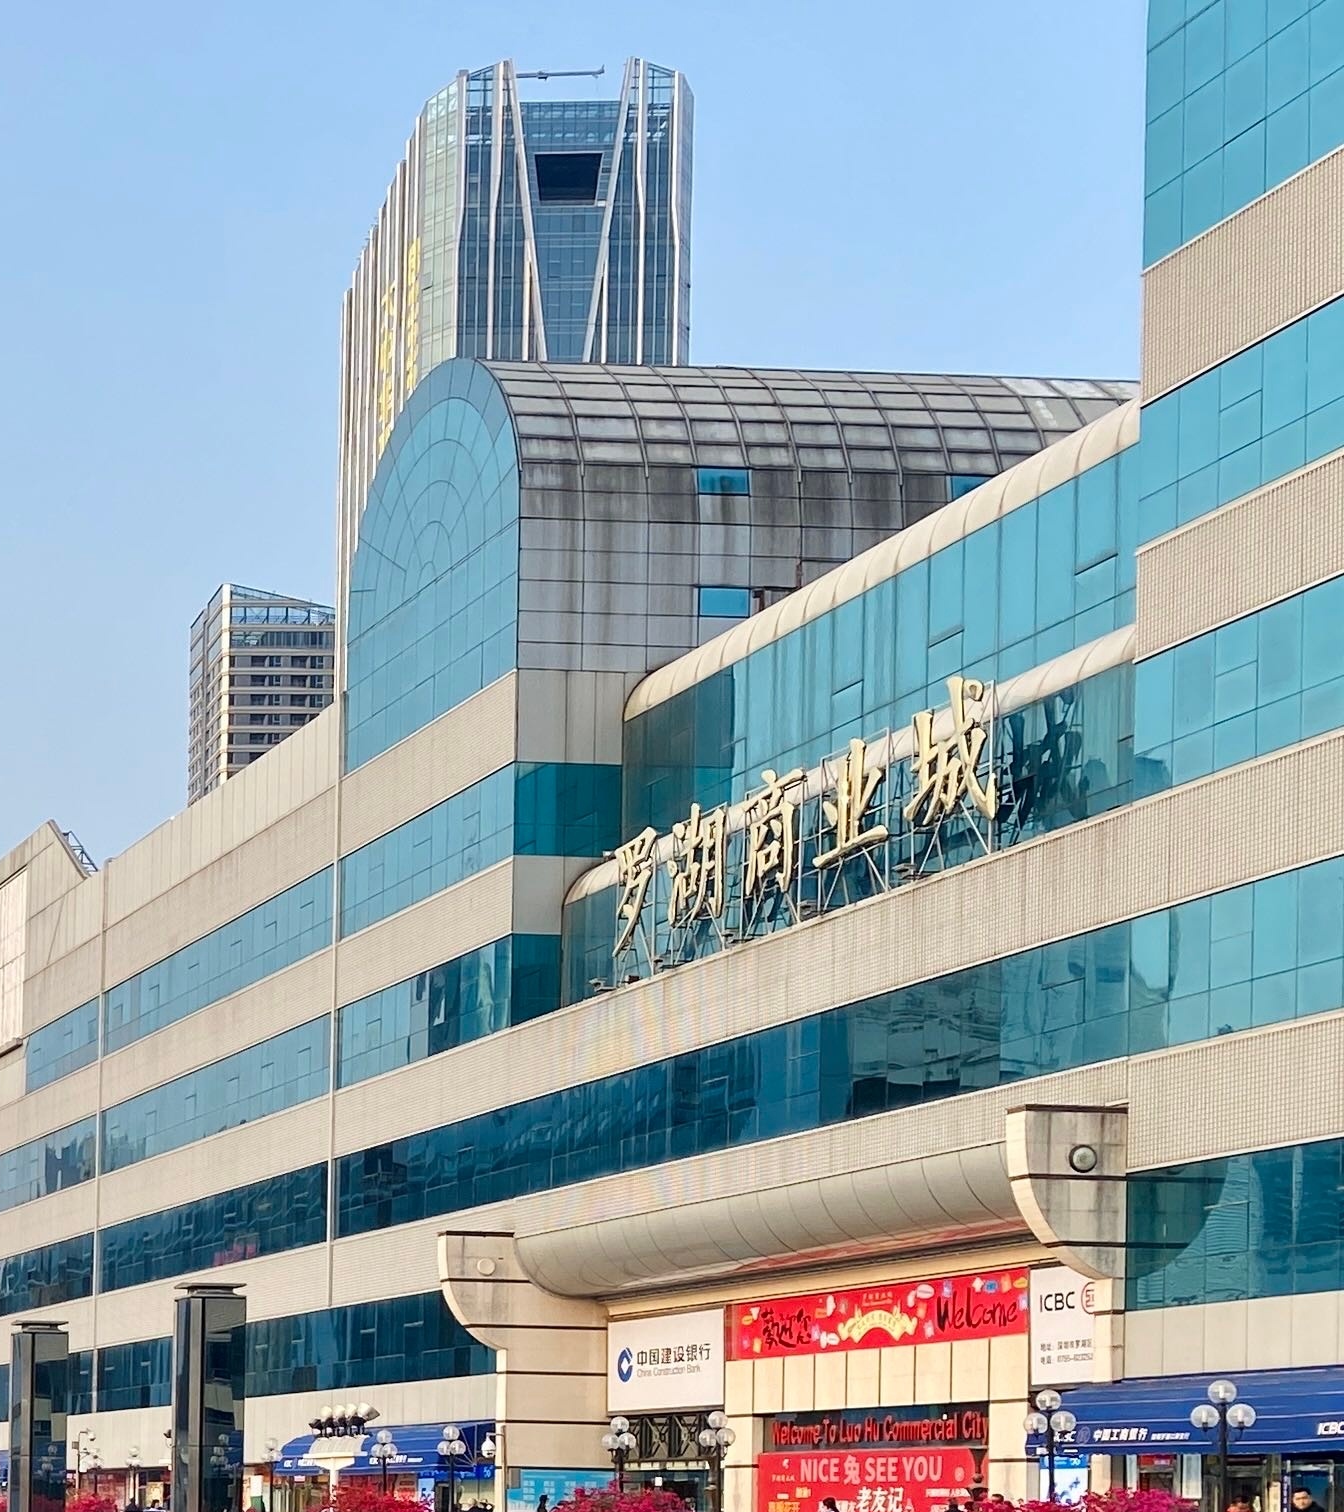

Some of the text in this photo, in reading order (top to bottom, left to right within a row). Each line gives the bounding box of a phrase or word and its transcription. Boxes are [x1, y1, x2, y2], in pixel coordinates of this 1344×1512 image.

[612, 676, 999, 956] 罗湖商业城
[936, 1288, 1018, 1332] Welcome
[1039, 1291, 1076, 1312] ICBC
[636, 1343, 711, 1366] 中国建设银行
[636, 1364, 702, 1378] China Construction Bank
[772, 1411, 989, 1446] Welcome To Luo Hu Commercial City
[1093, 1427, 1148, 1442] 中国工商银行
[800, 1454, 943, 1485] NICE 兔 SEE YOU
